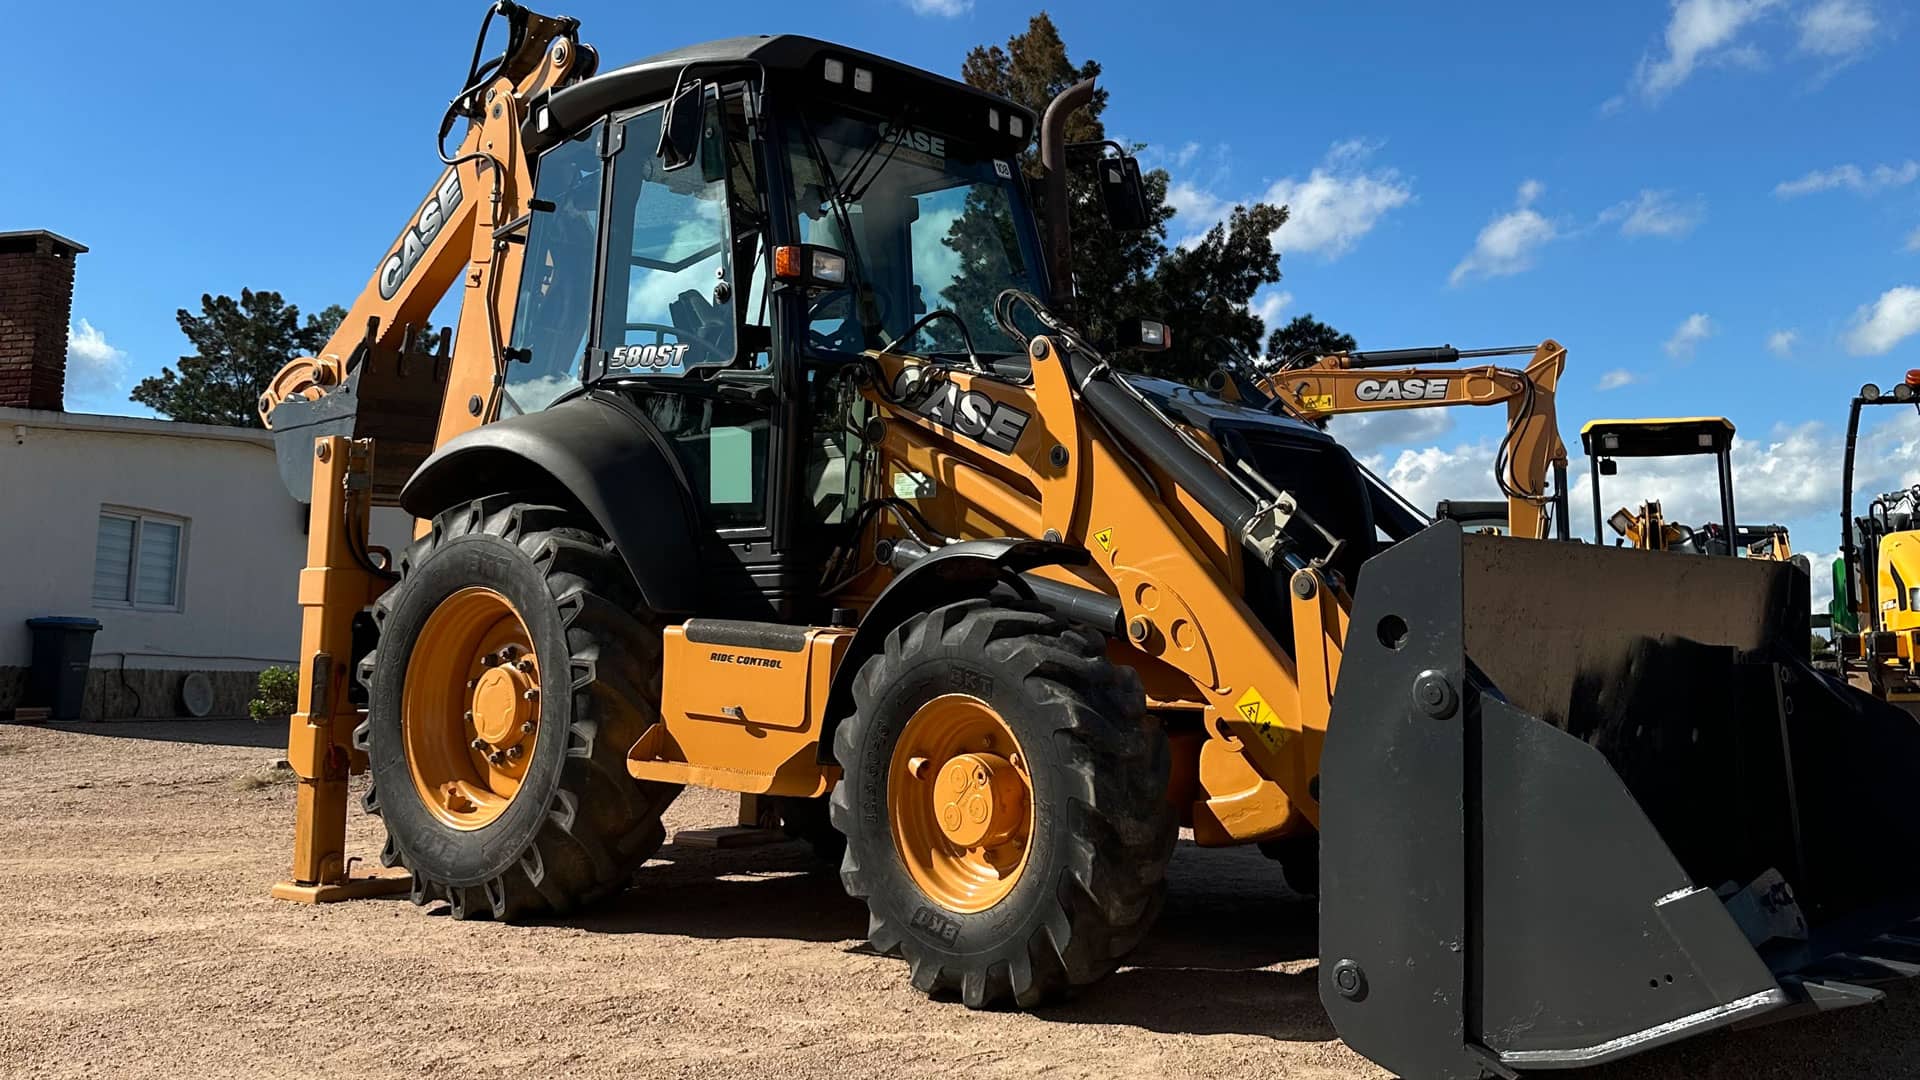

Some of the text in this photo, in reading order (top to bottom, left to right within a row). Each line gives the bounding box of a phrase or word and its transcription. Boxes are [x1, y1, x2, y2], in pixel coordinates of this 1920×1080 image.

[379, 166, 463, 300] CASE
[609, 343, 689, 369] 580ST
[1355, 378, 1449, 401] CASE
[710, 652, 783, 669] RIDE CONTROL
